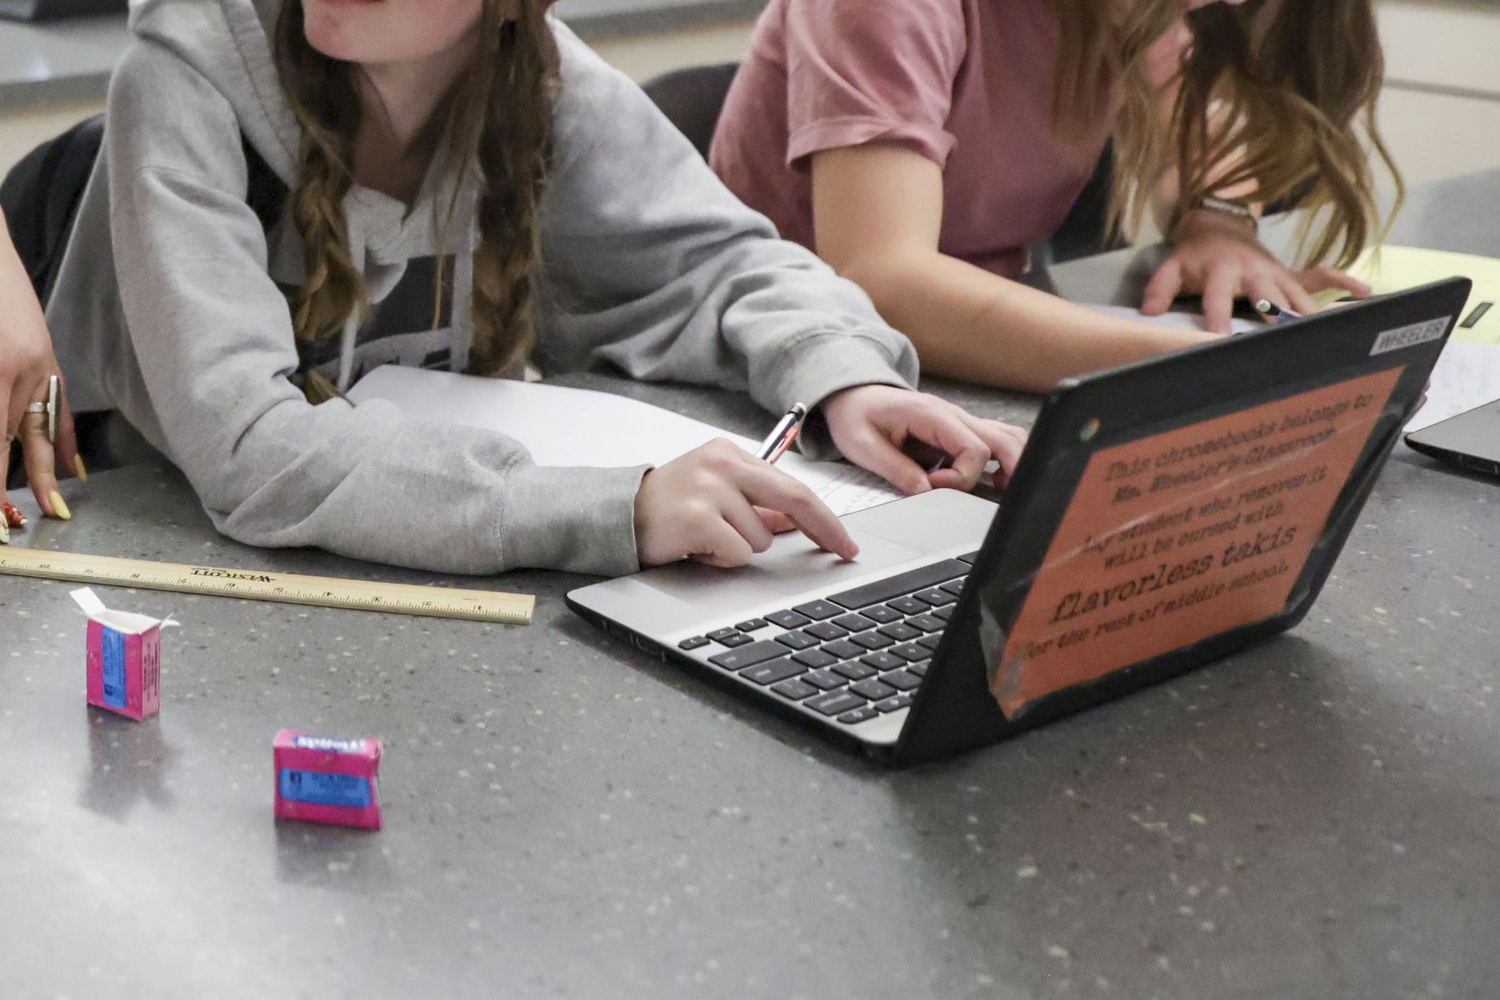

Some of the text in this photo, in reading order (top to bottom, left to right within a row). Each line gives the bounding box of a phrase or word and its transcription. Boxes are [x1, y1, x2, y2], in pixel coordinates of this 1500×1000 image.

[1378, 320, 1445, 351] WHEELER
[190, 568, 276, 583] WESTCOTT
[1047, 525, 1299, 625] flavorless takis
